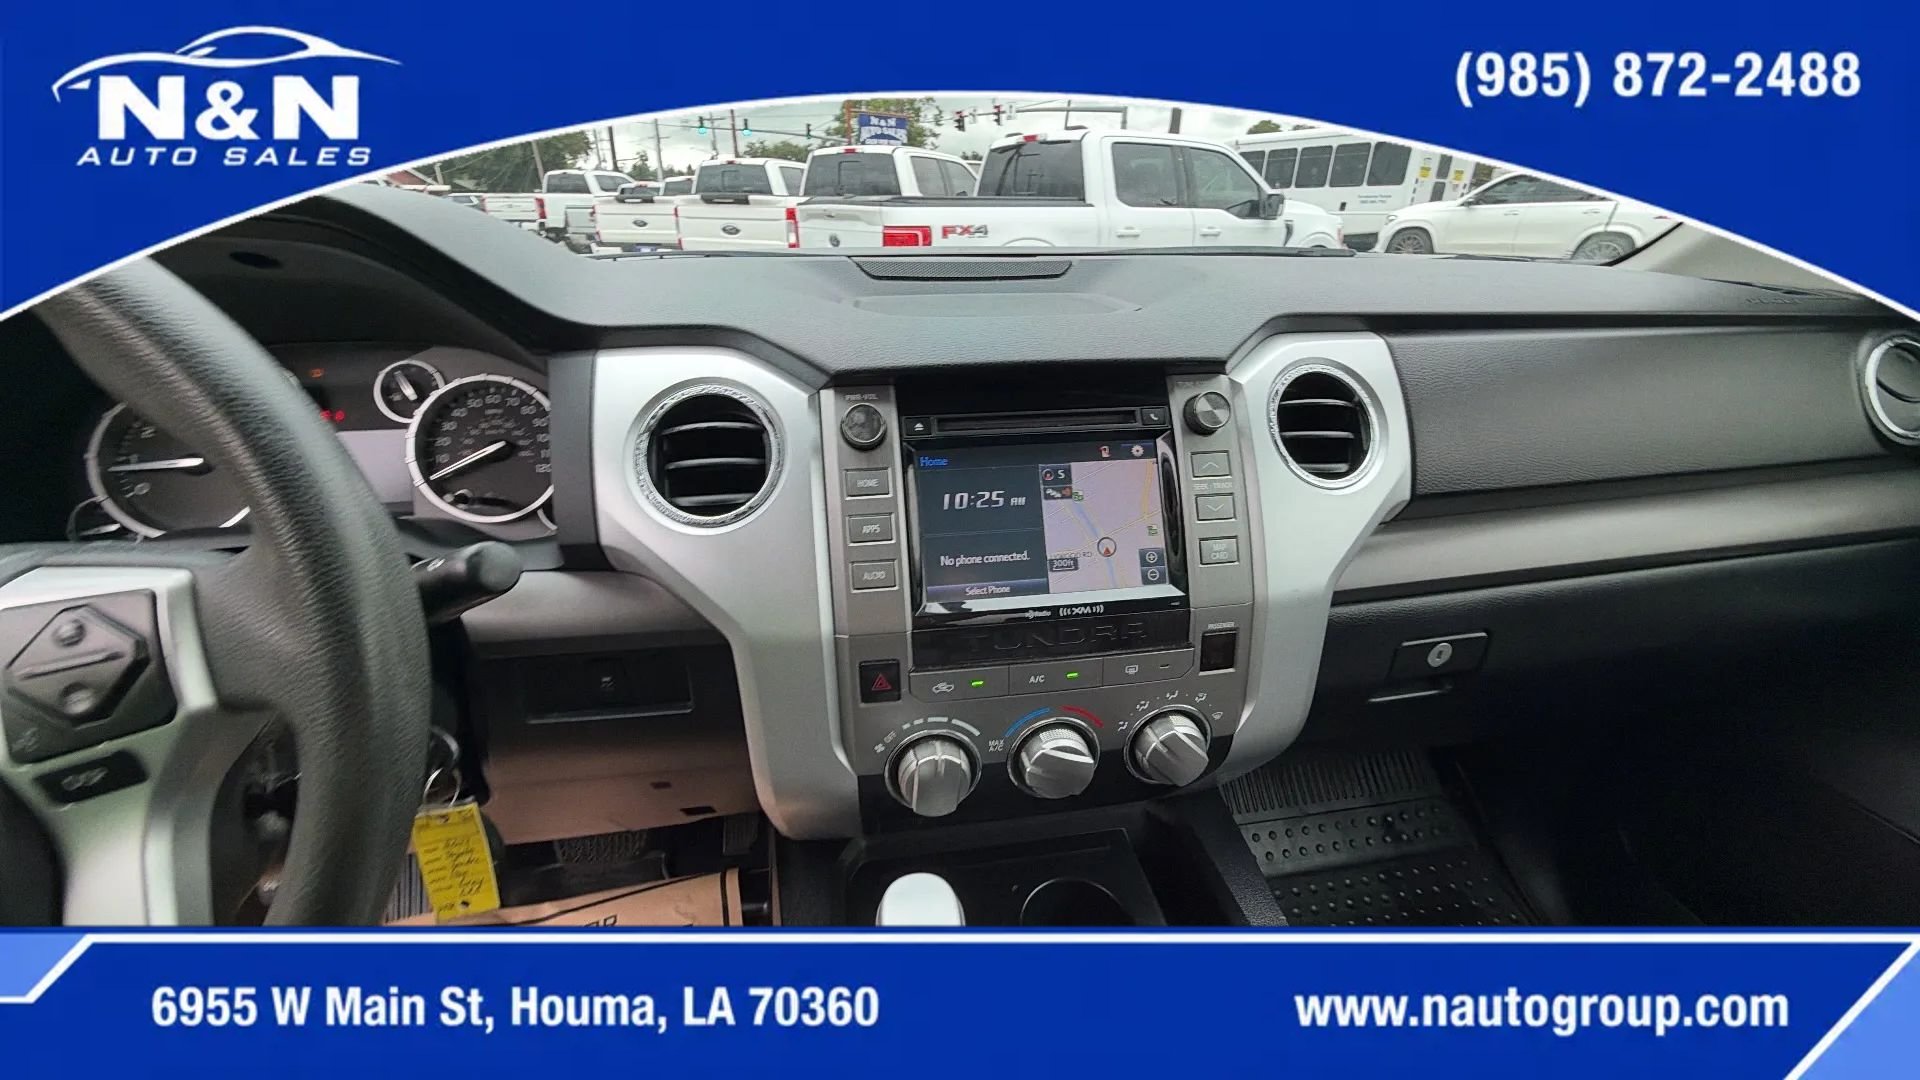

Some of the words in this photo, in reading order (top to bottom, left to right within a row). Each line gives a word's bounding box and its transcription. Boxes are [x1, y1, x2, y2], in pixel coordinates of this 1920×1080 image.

[941, 224, 988, 239] FX4
[467, 399, 483, 408] 50
[485, 395, 502, 404] 60
[505, 397, 520, 407] 70
[451, 408, 468, 417] 40
[520, 405, 537, 415] 80
[441, 421, 458, 431] 30
[435, 437, 452, 446] 20
[436, 454, 450, 463] 10
[919, 456, 948, 467] Home
[1057, 470, 1066, 479] S
[856, 479, 879, 488] HOME
[943, 490, 1005, 510] 10:25
[1010, 497, 1026, 506] AM
[862, 524, 881, 534] APPS
[940, 555, 954, 566] No
[955, 554, 982, 567] phone
[983, 550, 1030, 563] connected.
[863, 571, 886, 581] AUDIO
[965, 586, 987, 595] Select
[988, 585, 1011, 594] Phone
[1029, 674, 1046, 684] A/C
[988, 739, 1004, 747] MAX
